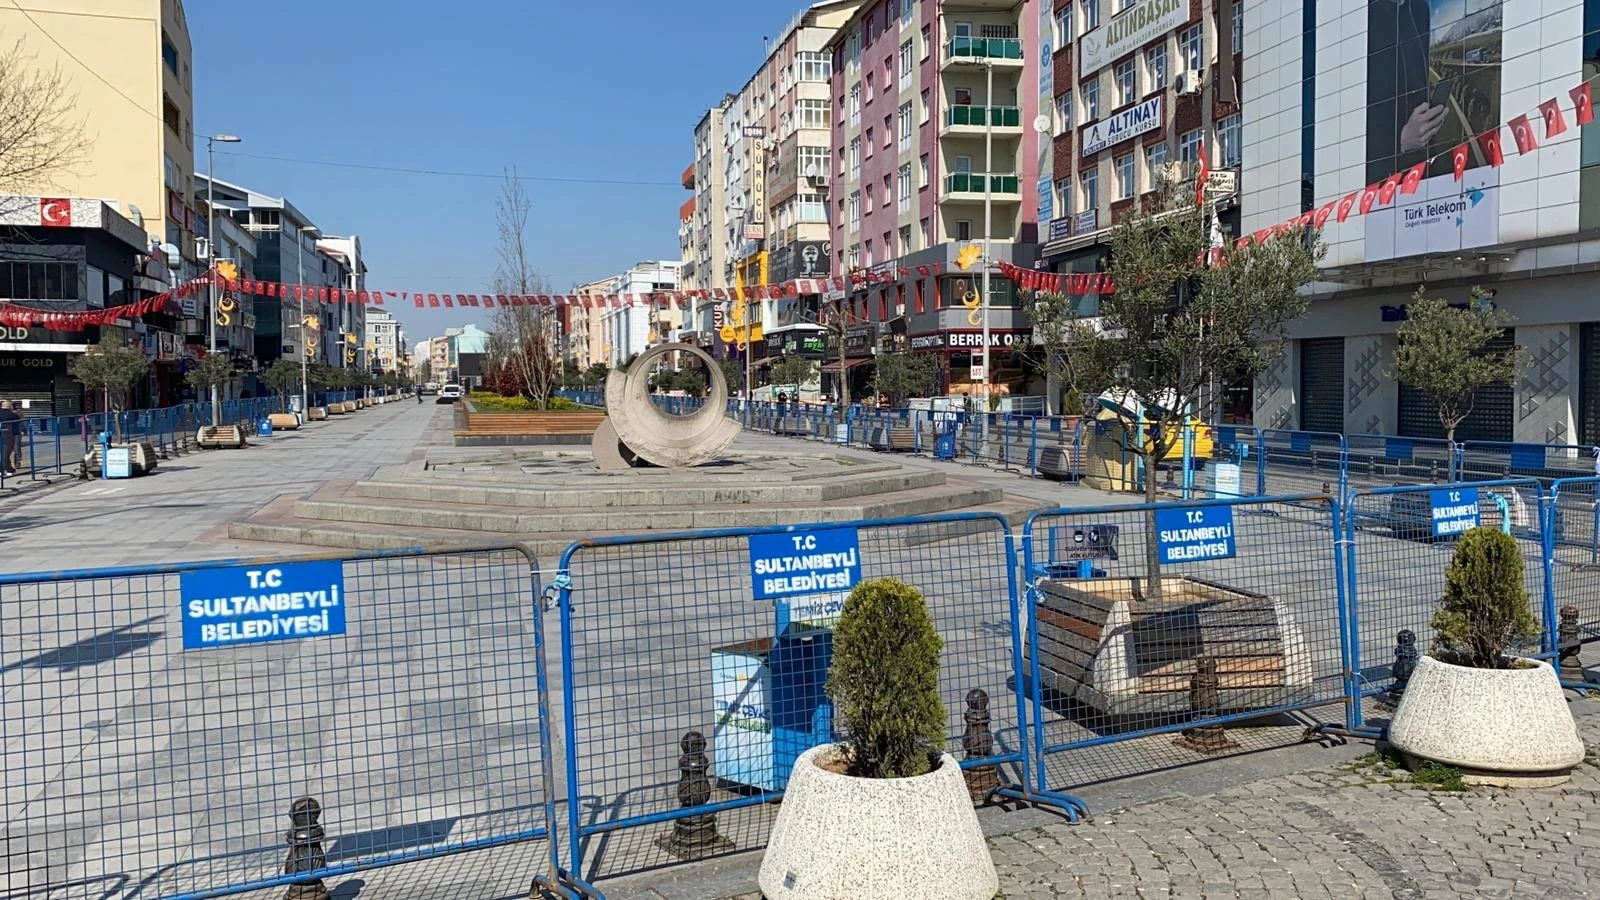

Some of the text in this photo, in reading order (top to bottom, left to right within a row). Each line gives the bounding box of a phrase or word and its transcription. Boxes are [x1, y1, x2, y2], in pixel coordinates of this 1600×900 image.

[1108, 98, 1159, 137] ALTINAY
[1134, 118, 1157, 134] KURSU
[1404, 201, 1467, 220] Türk Telekom
[0, 358, 53, 367] UR GOLD
[1449, 491, 1460, 502] T.C
[1186, 510, 1204, 523] T.C
[1432, 500, 1478, 519] SULTANBEYLİ
[1160, 522, 1231, 543] SULTANBEYLİ
[1437, 515, 1476, 534] BELEDİYESİ
[792, 535, 816, 550] T.C
[1167, 539, 1228, 560] BELEDİYESİ
[754, 547, 857, 575] SULTANBEYLİ
[246, 568, 283, 589] T.C
[763, 567, 850, 595] BELEDİYESİ
[188, 584, 339, 618] SULTANBEYLİ
[825, 600, 845, 616] ÇEV
[201, 609, 329, 642] BELEDİYESİ
